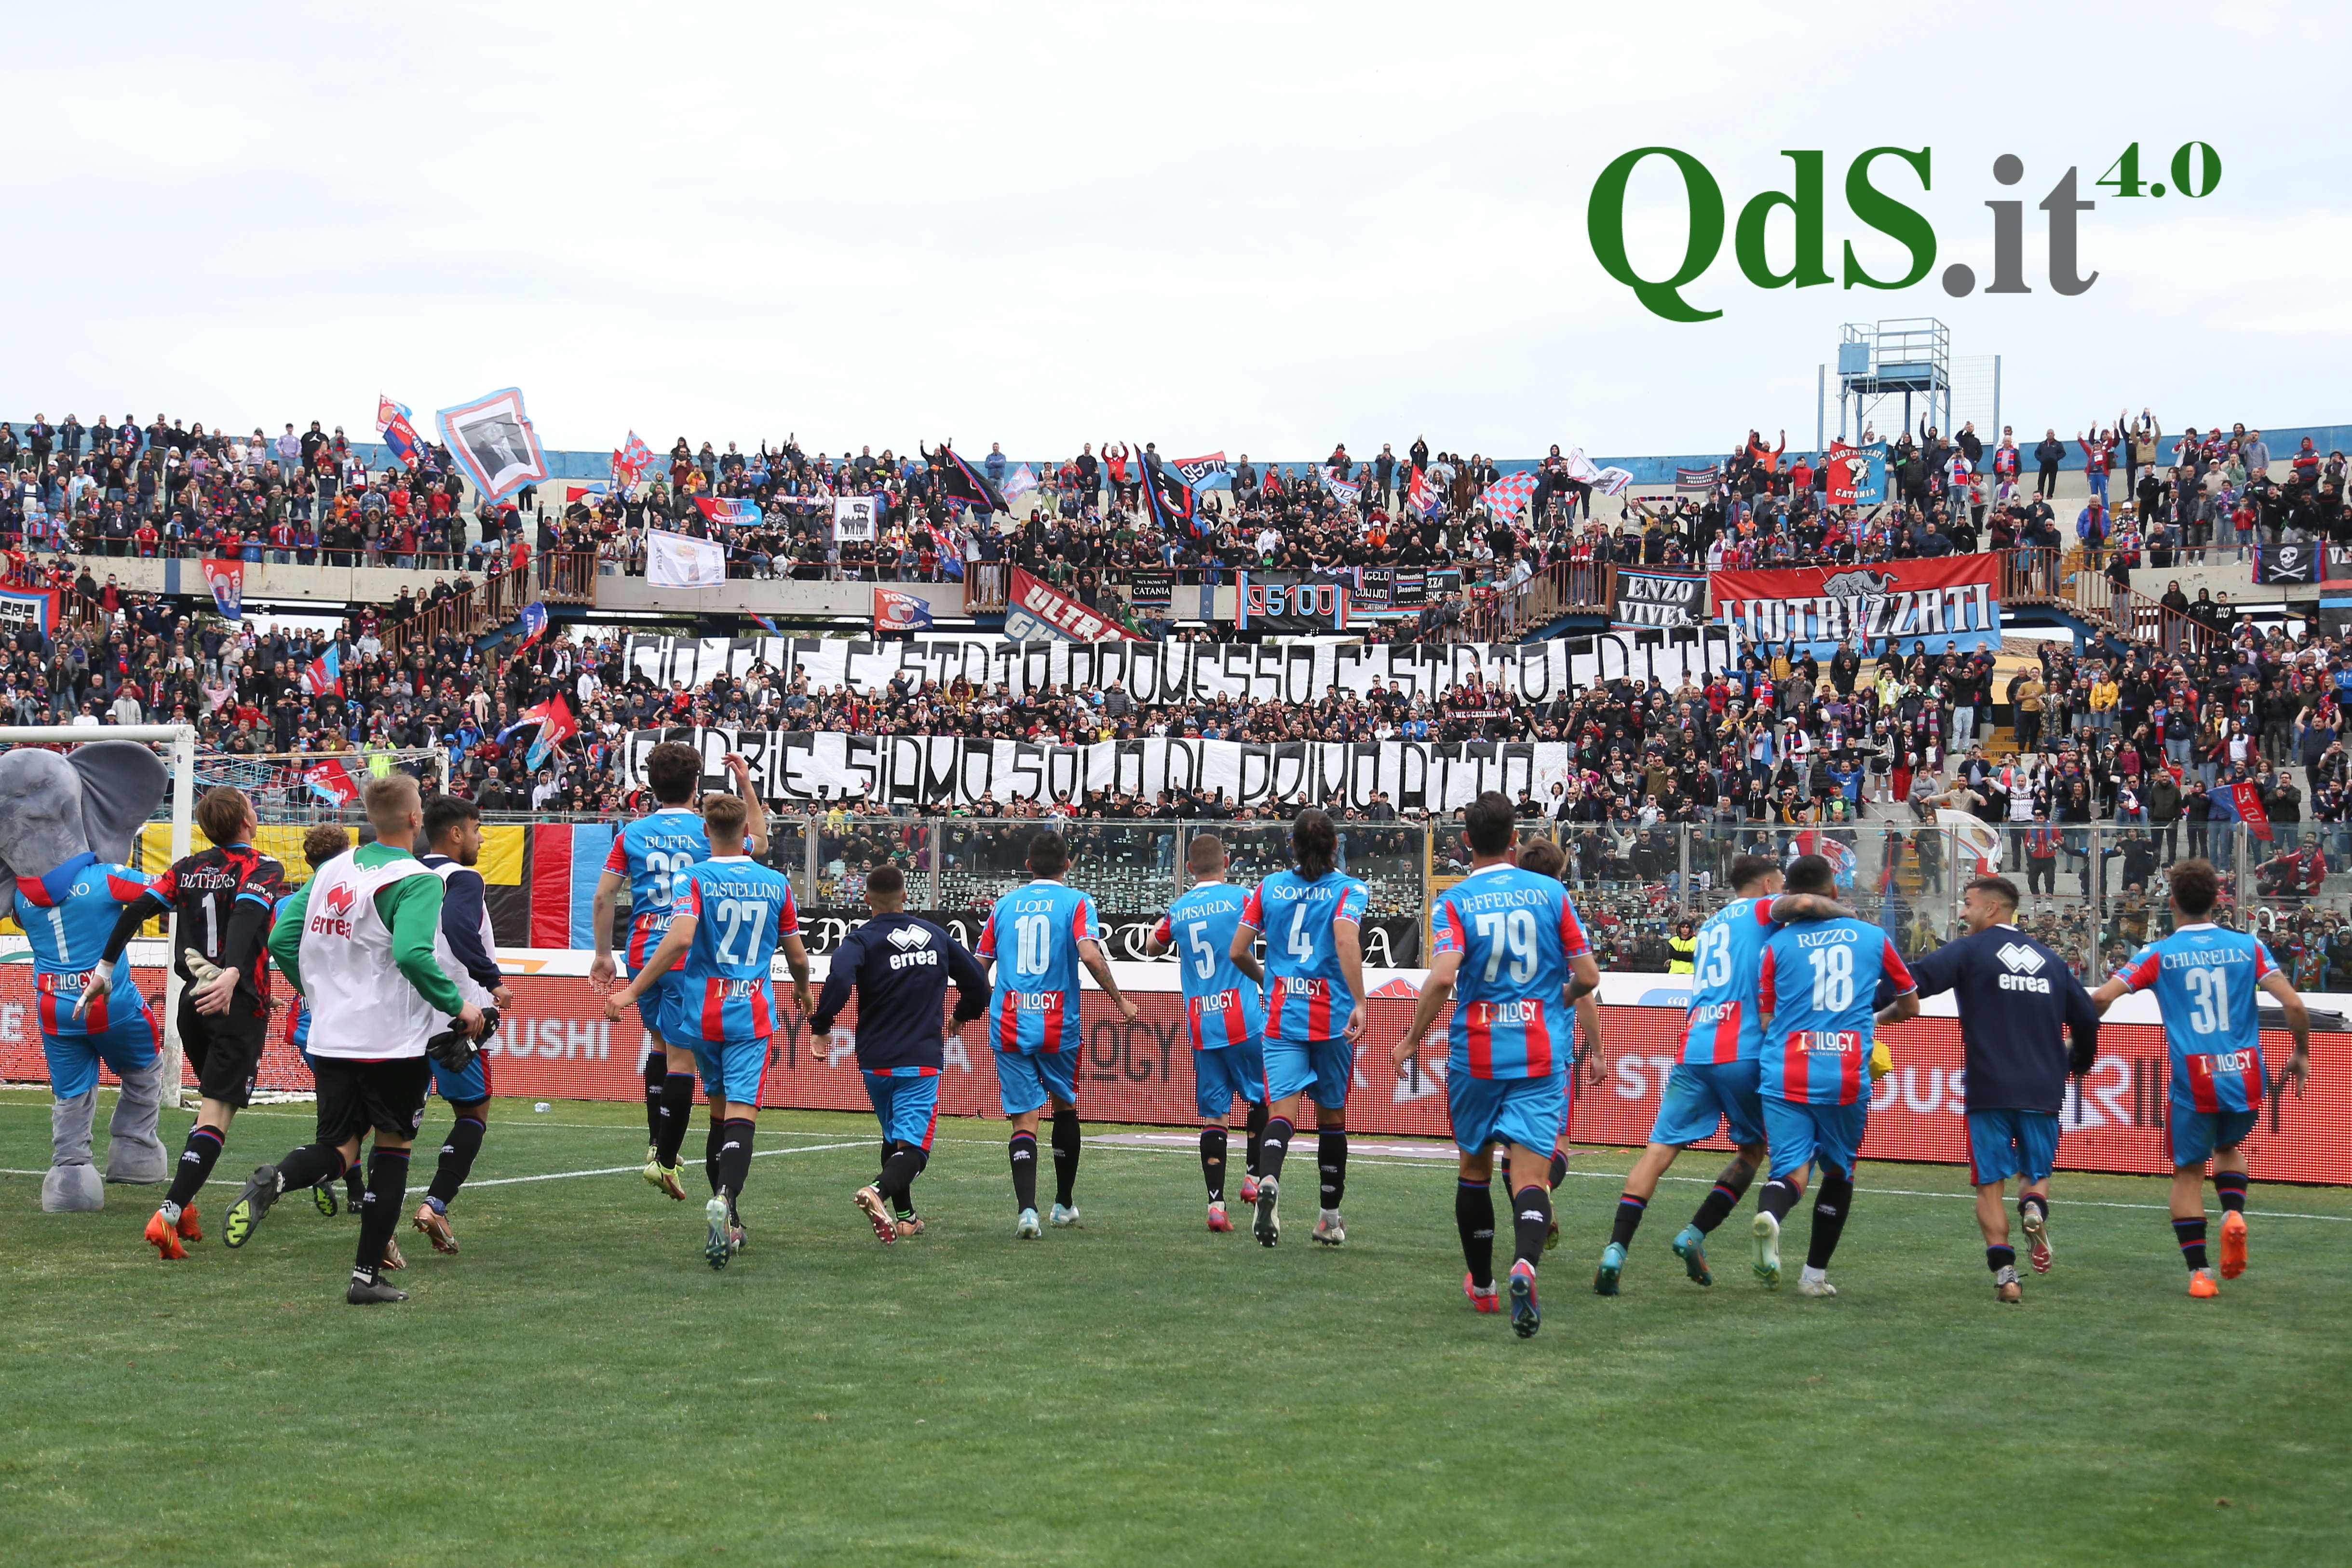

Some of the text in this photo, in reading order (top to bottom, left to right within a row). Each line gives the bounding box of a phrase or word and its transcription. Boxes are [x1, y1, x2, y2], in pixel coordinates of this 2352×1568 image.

[1835, 488, 1876, 499] CATANIA
[1363, 571, 1390, 581] NGELO
[1133, 587, 1170, 595] CATANIA
[1247, 584, 1335, 616] 95100
[1372, 589, 1388, 600] NOI
[1626, 577, 1694, 603] ENZO
[1024, 584, 1135, 643] ULTRA
[1618, 601, 1677, 626] VIVE
[645, 835, 701, 849] BUFFA
[246, 882, 274, 901] REPLAY
[703, 881, 780, 900] CASTELLINI
[1272, 885, 1334, 901] SOMMA
[1462, 889, 1549, 913] JEFFERSON
[1015, 899, 1054, 913] LODI
[1171, 900, 1237, 926] RAPISARDA
[47, 907, 70, 963] 1
[202, 892, 218, 958] 1
[311, 915, 351, 941] errea
[716, 898, 768, 967] 27
[1288, 903, 1313, 963] 4
[1014, 914, 1051, 975] 10
[1188, 920, 1216, 980] 5
[1475, 909, 1538, 984] 79
[1797, 928, 1858, 949] RIZZO
[889, 950, 937, 971] errea
[1693, 922, 1732, 996] 23
[2163, 948, 2252, 970] CHIARELLA
[1809, 944, 1853, 1012] 18
[1999, 973, 2051, 994] errea
[1010, 991, 1058, 1011] TRILOGY
[1480, 1001, 1537, 1023] TRILOGY
[2185, 967, 2230, 1034] 31
[1799, 1032, 1854, 1053] TRILOGY
[2199, 1051, 2252, 1075] TRILOGY
